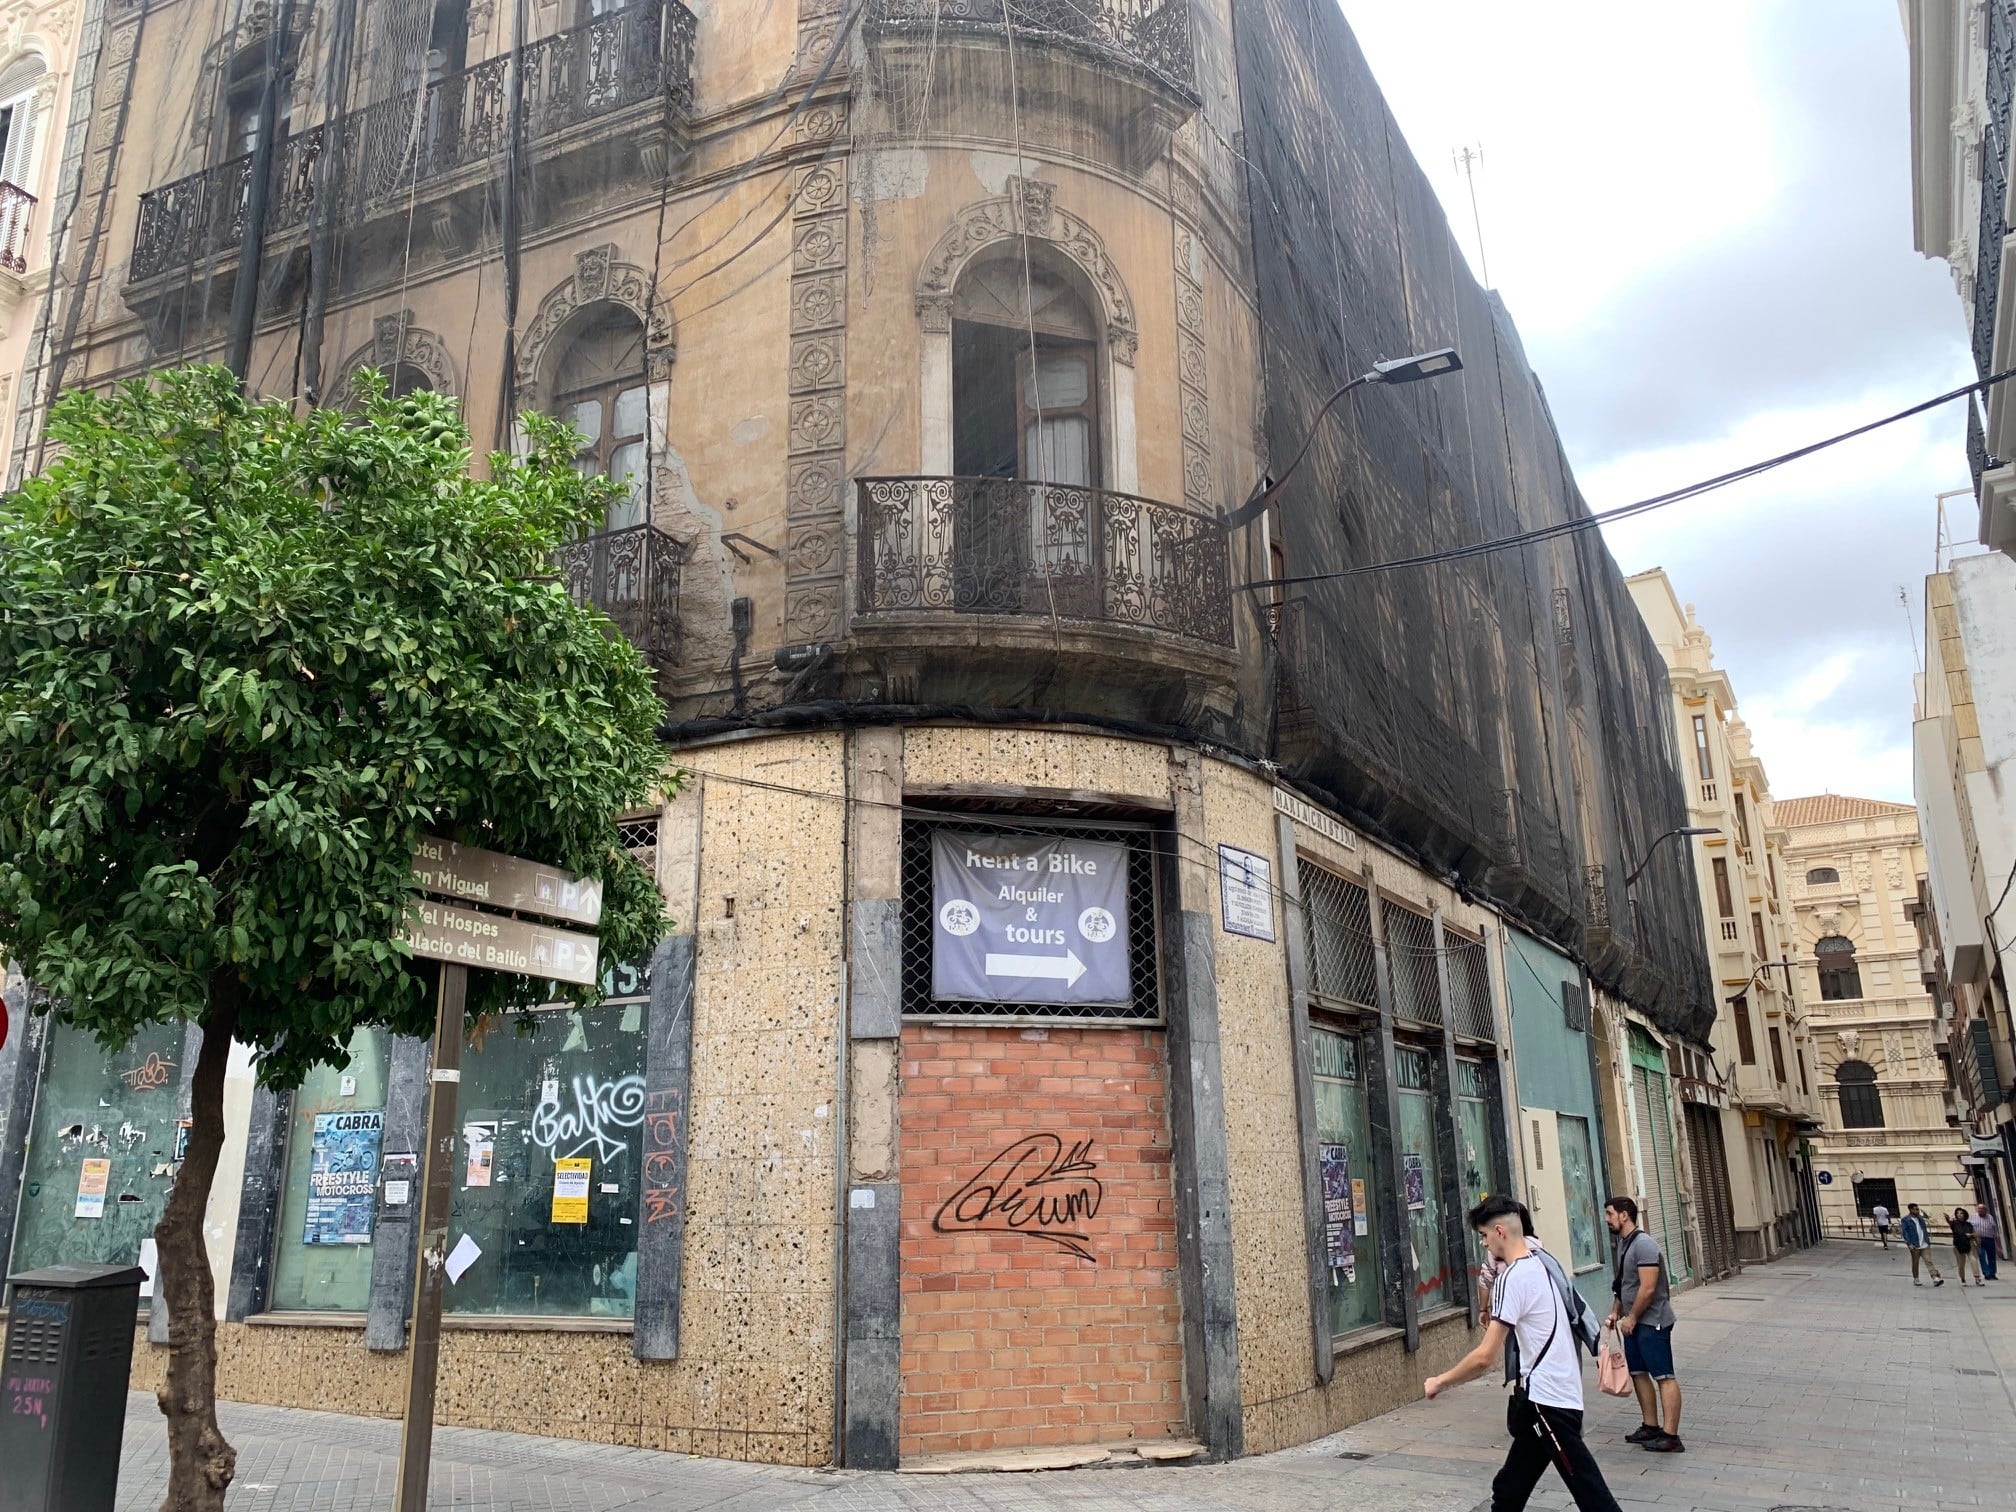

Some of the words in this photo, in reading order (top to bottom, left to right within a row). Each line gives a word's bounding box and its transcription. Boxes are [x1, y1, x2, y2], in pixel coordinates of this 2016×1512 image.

[1275, 790, 1308, 823] MARIA
[1310, 811, 1356, 849] CRISTINA
[414, 842, 443, 861] otel
[966, 849, 1020, 871] Rent
[1025, 856, 1038, 872] a
[1048, 853, 1097, 876] Bike
[413, 870, 432, 885] an
[438, 871, 489, 897] Miguel
[998, 885, 1064, 905] Alquiler
[402, 903, 438, 925] tel
[443, 911, 499, 938] Hospes
[1025, 906, 1038, 922] &
[1005, 924, 1065, 945] tours
[457, 942, 481, 960] del
[486, 946, 527, 968] Bailío
[335, 1114, 381, 1130] CABRA
[310, 1170, 370, 1187] FREESTYLE
[316, 1184, 375, 1197] MOTOCROSS
